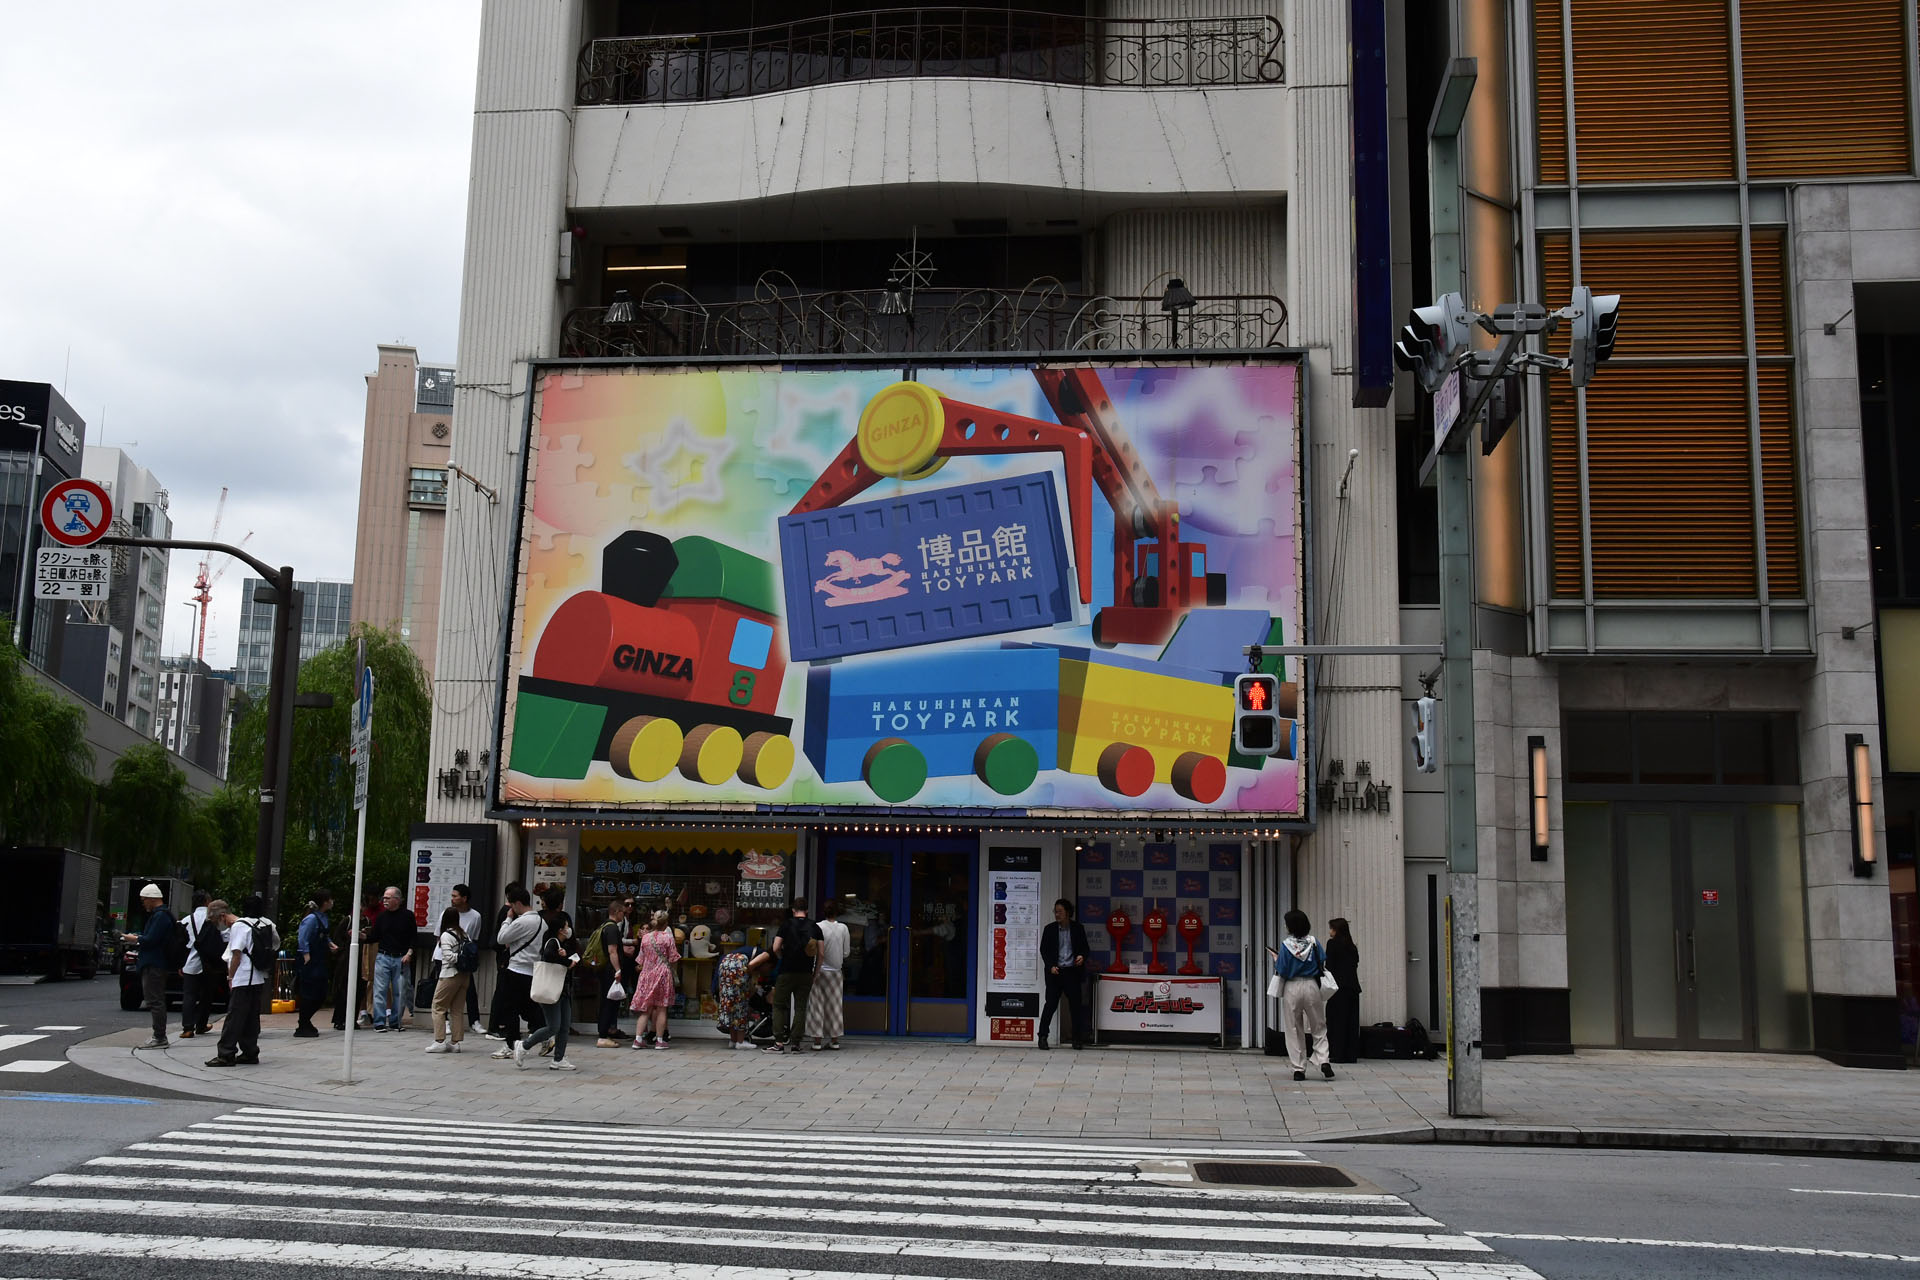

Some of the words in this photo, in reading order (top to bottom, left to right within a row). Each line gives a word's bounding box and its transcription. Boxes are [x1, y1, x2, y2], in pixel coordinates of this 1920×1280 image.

[872, 414, 921, 442] GINZA
[917, 523, 1027, 570] 博品館
[40, 552, 107, 566] タクシーを除く
[921, 556, 1031, 579] HAKUHINKAN
[922, 575, 967, 594] TOY
[976, 566, 1033, 586] PARK
[613, 644, 693, 681] GINZA
[728, 670, 756, 706] 8
[873, 697, 1019, 711] HAKUHINKAN
[872, 713, 932, 731] TOY
[944, 710, 1019, 729] PARK
[1112, 711, 1212, 733] HAKUHINKAN
[1111, 720, 1152, 738] TOY
[1159, 728, 1210, 746] PARK
[1329, 758, 1371, 777] 銀座
[436, 768, 488, 799] 博品
[594, 859, 646, 873] 宝島社の
[593, 881, 674, 896] おもちゃ屋さん
[737, 880, 784, 897] 博品館
